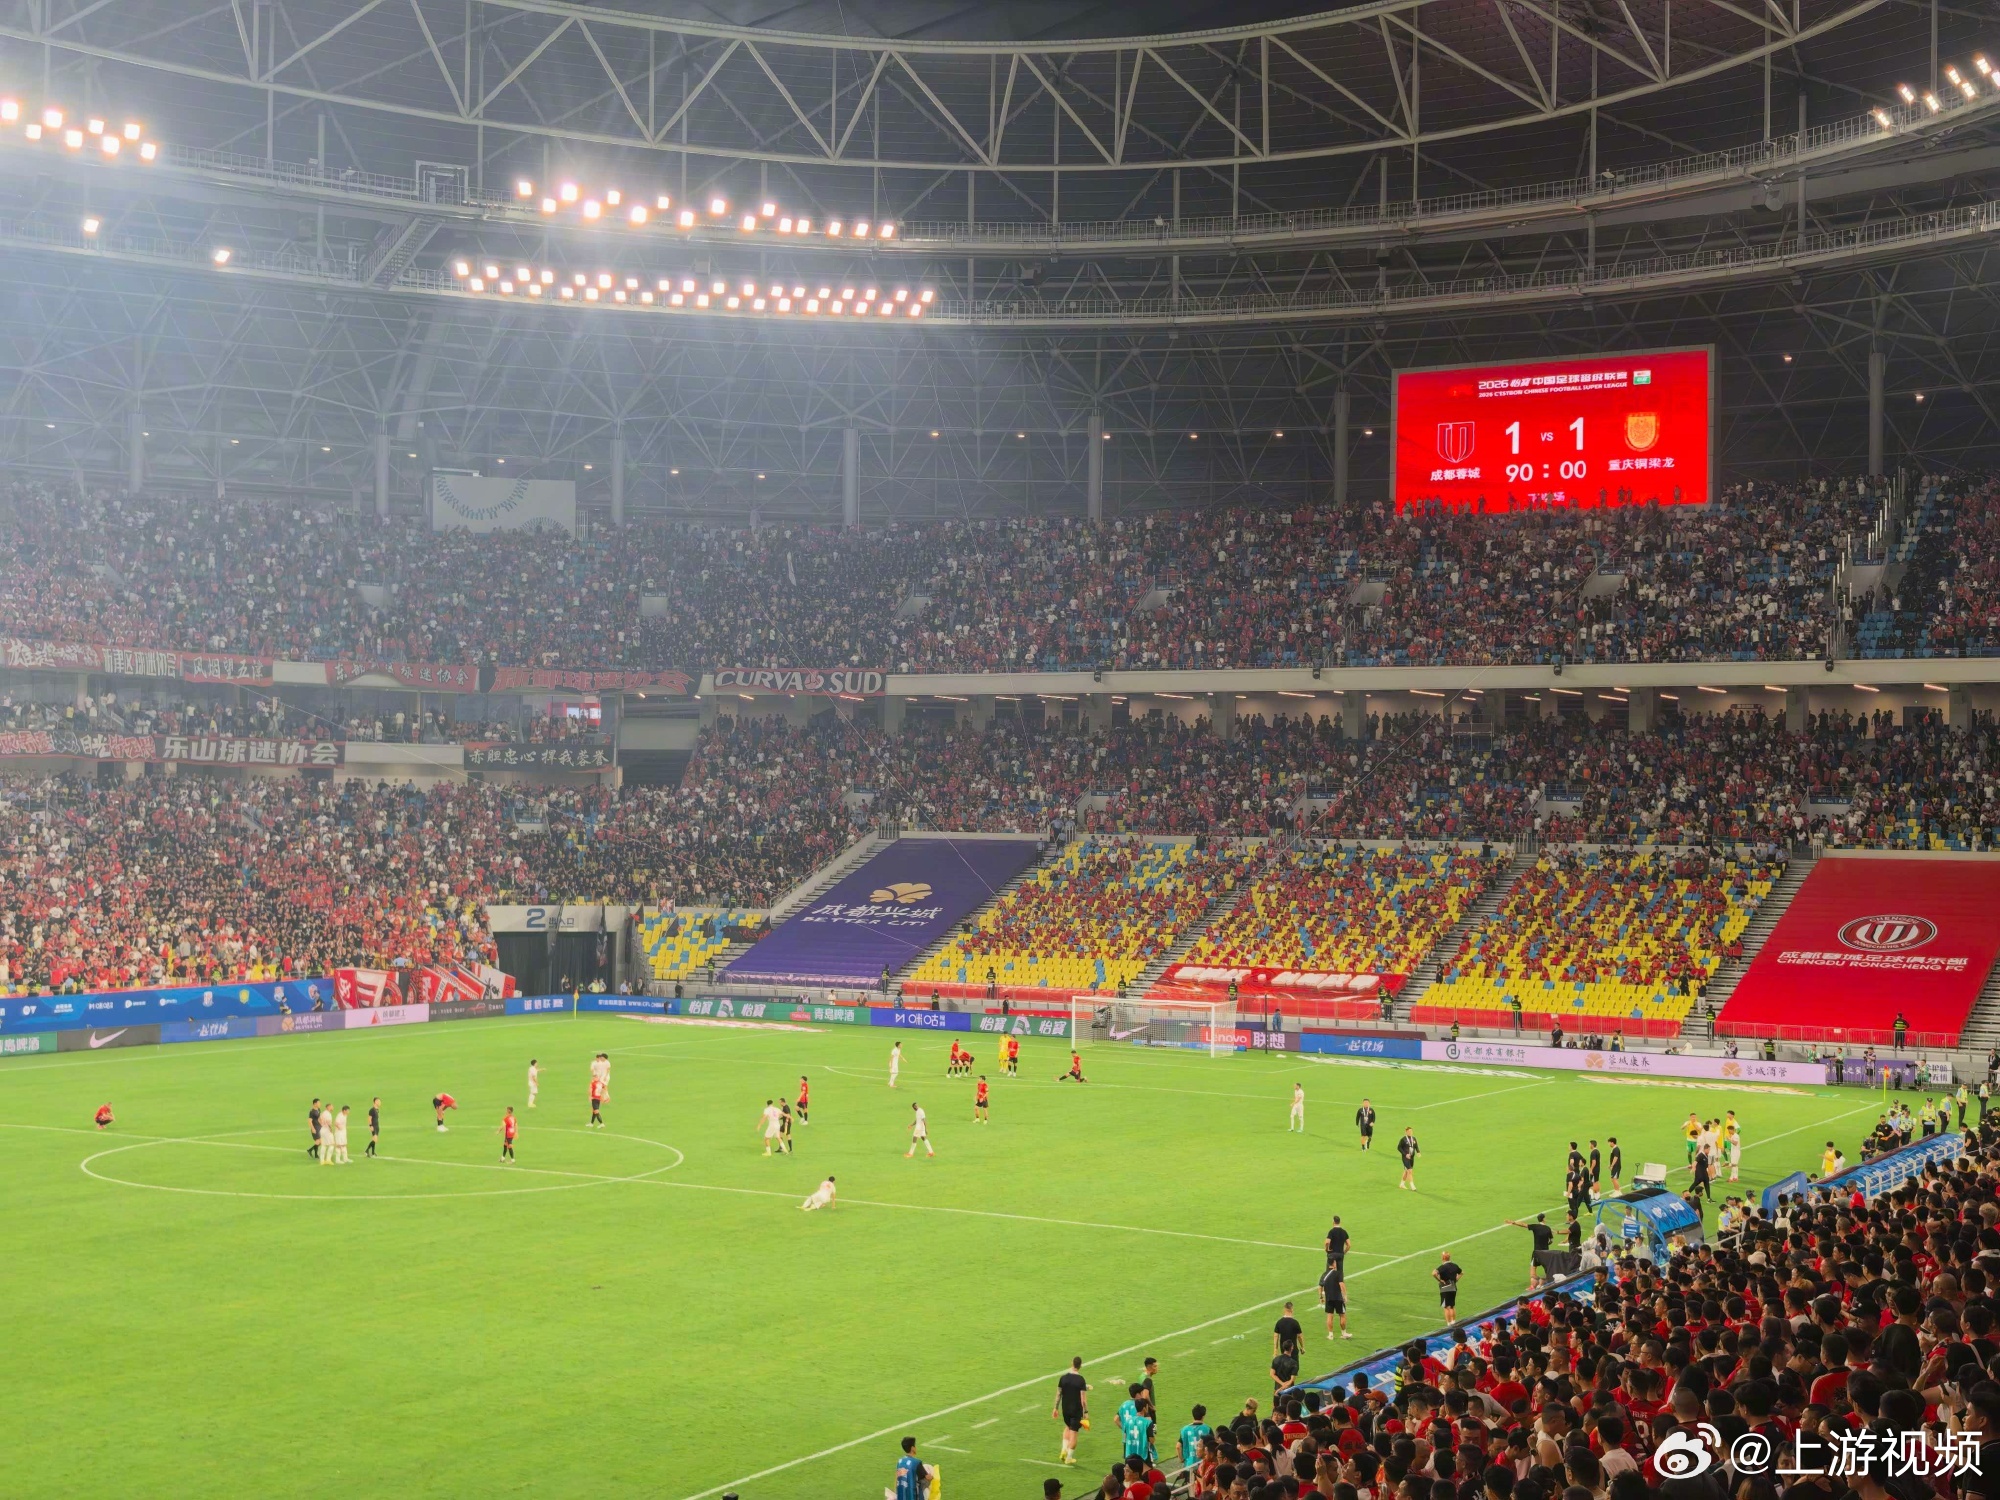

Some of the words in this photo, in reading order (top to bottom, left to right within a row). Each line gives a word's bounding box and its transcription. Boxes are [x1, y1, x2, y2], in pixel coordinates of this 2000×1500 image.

[1478, 379, 1509, 390] 2026
[1532, 371, 1628, 386] 中国足球超级联赛
[1524, 387, 1549, 395] CHINESE
[1550, 384, 1582, 393] FOOTBALL
[1583, 383, 1603, 391] SUPER
[1604, 381, 1628, 389] LEAGUE
[1505, 421, 1520, 454] 1
[1568, 417, 1584, 450] 1
[1608, 457, 1676, 471] 重庆铜梁龙
[1430, 466, 1481, 481] 成都蓉城
[715, 670, 803, 691] CURVA
[829, 671, 882, 694] SUD
[163, 736, 338, 765] 乐山球迷协会
[469, 748, 537, 765] 赤胆忠心
[526, 908, 546, 928] 2
[812, 903, 943, 919] 成都兴城
[802, 917, 881, 925] BETTER
[1777, 958, 1846, 967] CHENGDU
[1850, 961, 1942, 972] RONGCHENG
[1778, 951, 1969, 966] 成都蓉城足球俱乐部
[814, 1007, 855, 1022] 青岛啤酒
[909, 1013, 938, 1027] 咪咕
[1253, 1032, 1285, 1048] 联想
